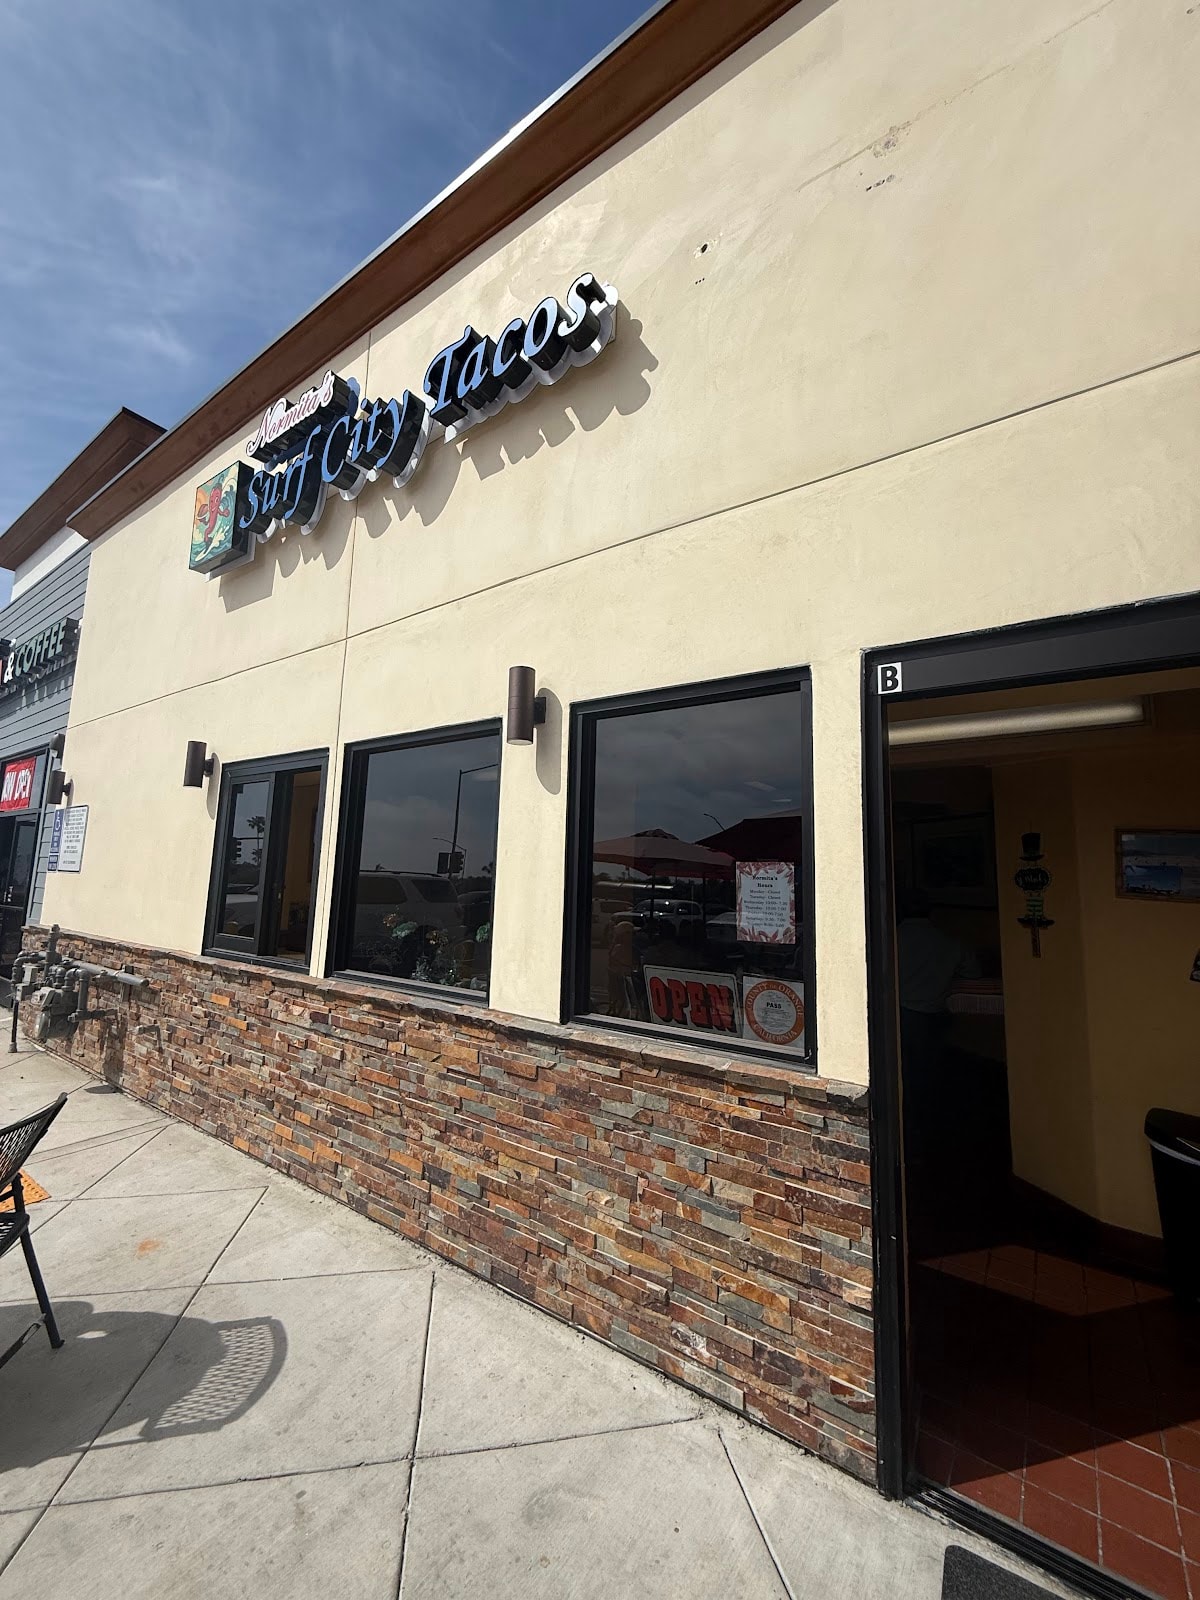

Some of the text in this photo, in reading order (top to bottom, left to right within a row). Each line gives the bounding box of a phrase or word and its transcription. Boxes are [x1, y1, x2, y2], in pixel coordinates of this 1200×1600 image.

[239, 272, 593, 529] Surf City Tacos
[246, 370, 335, 457] Normita's
[3, 618, 68, 684] & COFFEE
[881, 665, 899, 692] B
[650, 976, 738, 1033] OPEN
[746, 983, 768, 1009] COUNTY
[778, 984, 804, 1016] ORANGE
[754, 1024, 798, 1042] CALIFORNIA
